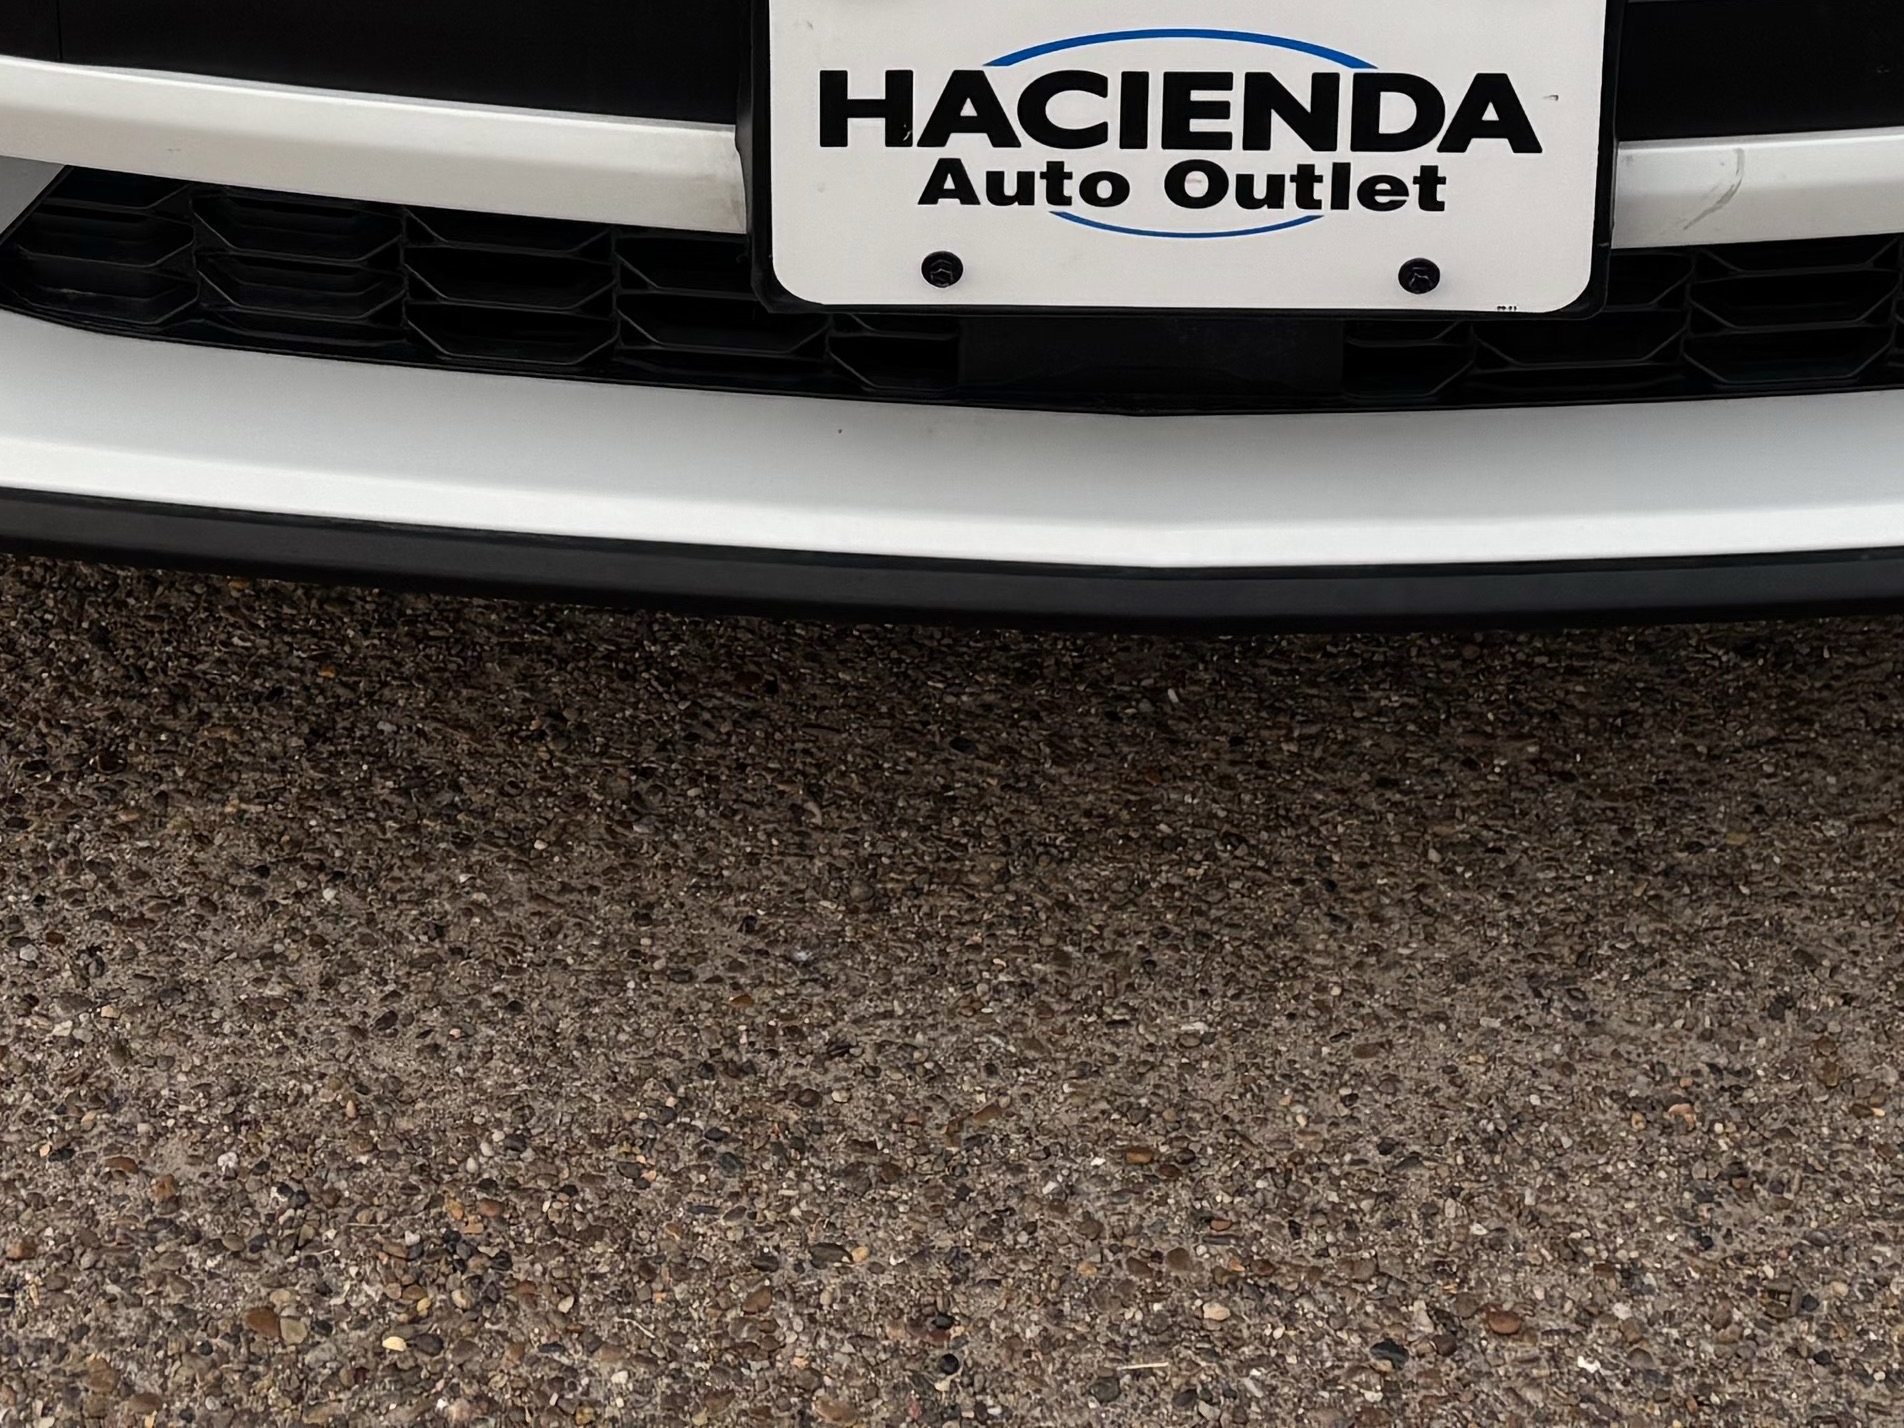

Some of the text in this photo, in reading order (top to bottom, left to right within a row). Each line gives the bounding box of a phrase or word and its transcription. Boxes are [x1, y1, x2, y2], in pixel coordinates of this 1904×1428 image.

[819, 69, 1543, 154] HACIENDA
[917, 157, 1447, 212] Auto Outlet
